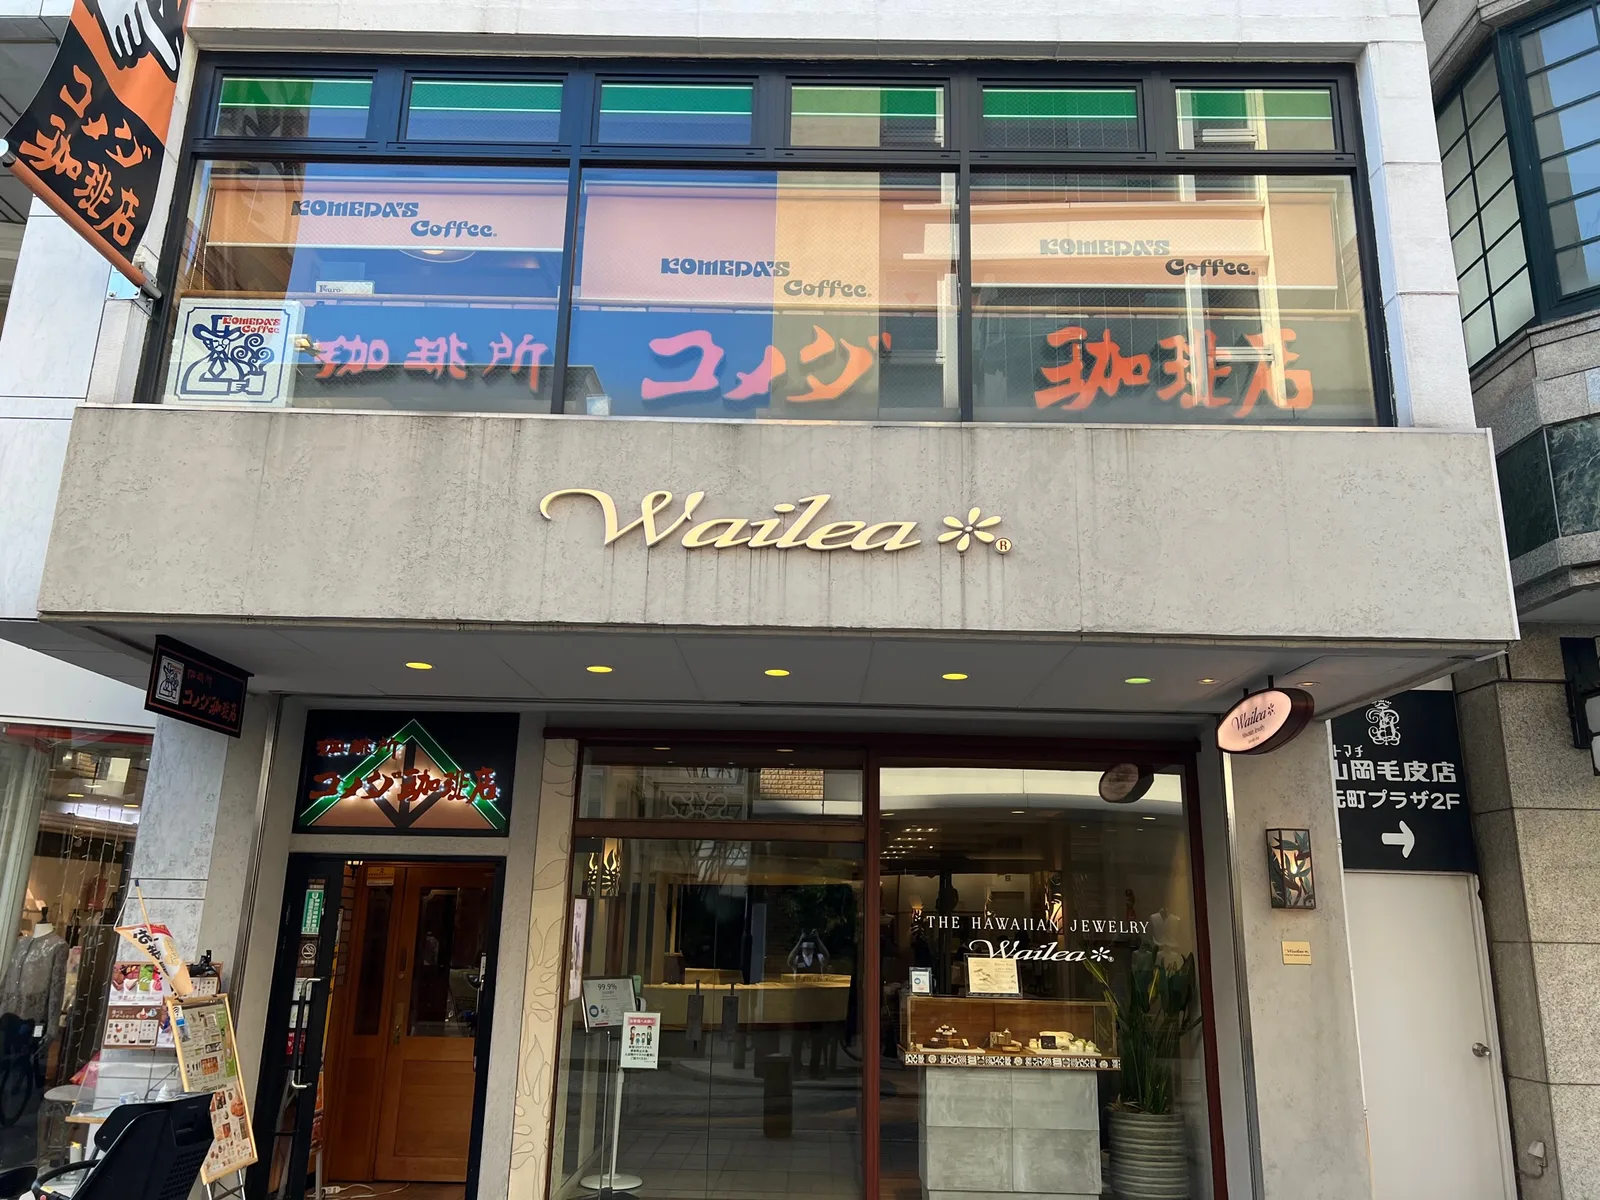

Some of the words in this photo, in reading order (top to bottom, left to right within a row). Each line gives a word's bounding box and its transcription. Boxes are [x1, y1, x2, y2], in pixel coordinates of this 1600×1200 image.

[60, 65, 151, 168] コメダ
[18, 113, 141, 247] 珈琲店
[291, 200, 419, 218] KOMEDA'S
[1039, 238, 1171, 257] KOMEDA'S
[660, 258, 790, 278] KOMEDA'S
[222, 316, 281, 326] KOMEDA'S
[241, 325, 280, 334] Coffee
[640, 324, 892, 403] コメダ
[1034, 326, 1314, 418] 珈琲店
[539, 487, 922, 551] Wailea
[1231, 706, 1267, 731] Wailea
[1334, 759, 1457, 783] 山岡毛皮店
[311, 768, 498, 807] コメダ珈琲店
[926, 915, 960, 929] THE
[972, 916, 1059, 932] HAWAIIAN
[1070, 919, 1149, 934] JEWELRY
[968, 939, 1087, 962] Wailea
